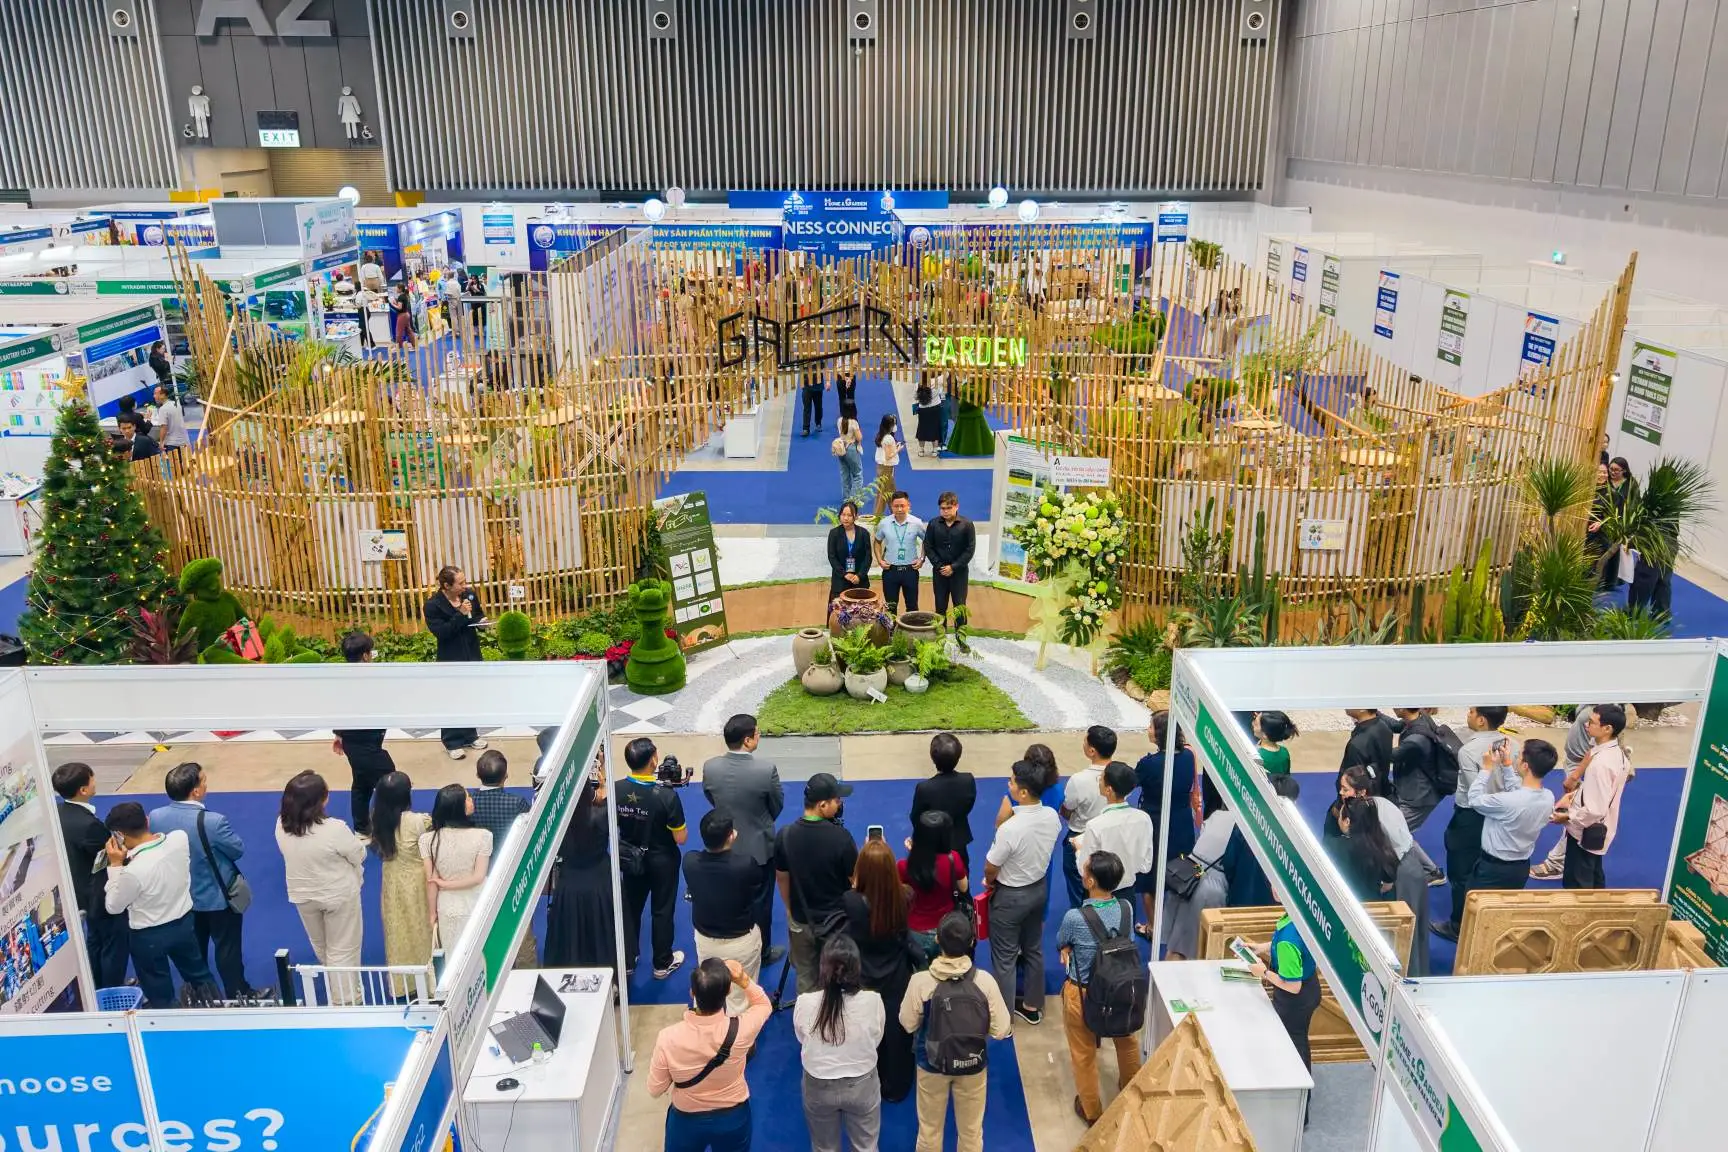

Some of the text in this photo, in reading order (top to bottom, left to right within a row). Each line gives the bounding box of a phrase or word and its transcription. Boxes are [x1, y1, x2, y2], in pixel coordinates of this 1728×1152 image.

[263, 132, 295, 142] EXIT
[365, 229, 388, 237] NINH
[751, 230, 772, 238] NINH
[925, 335, 1026, 367] GARDEN
[1225, 758, 1242, 793] TNHH
[1241, 785, 1289, 870] GREENOVATION
[1288, 864, 1332, 942] PACKAGING
[512, 875, 528, 913] CÔNG
[533, 824, 548, 862] TNHH
[953, 1057, 978, 1068] PUMA
[1416, 1058, 1445, 1118] GARDEN
[0, 1107, 285, 1152] urces?
